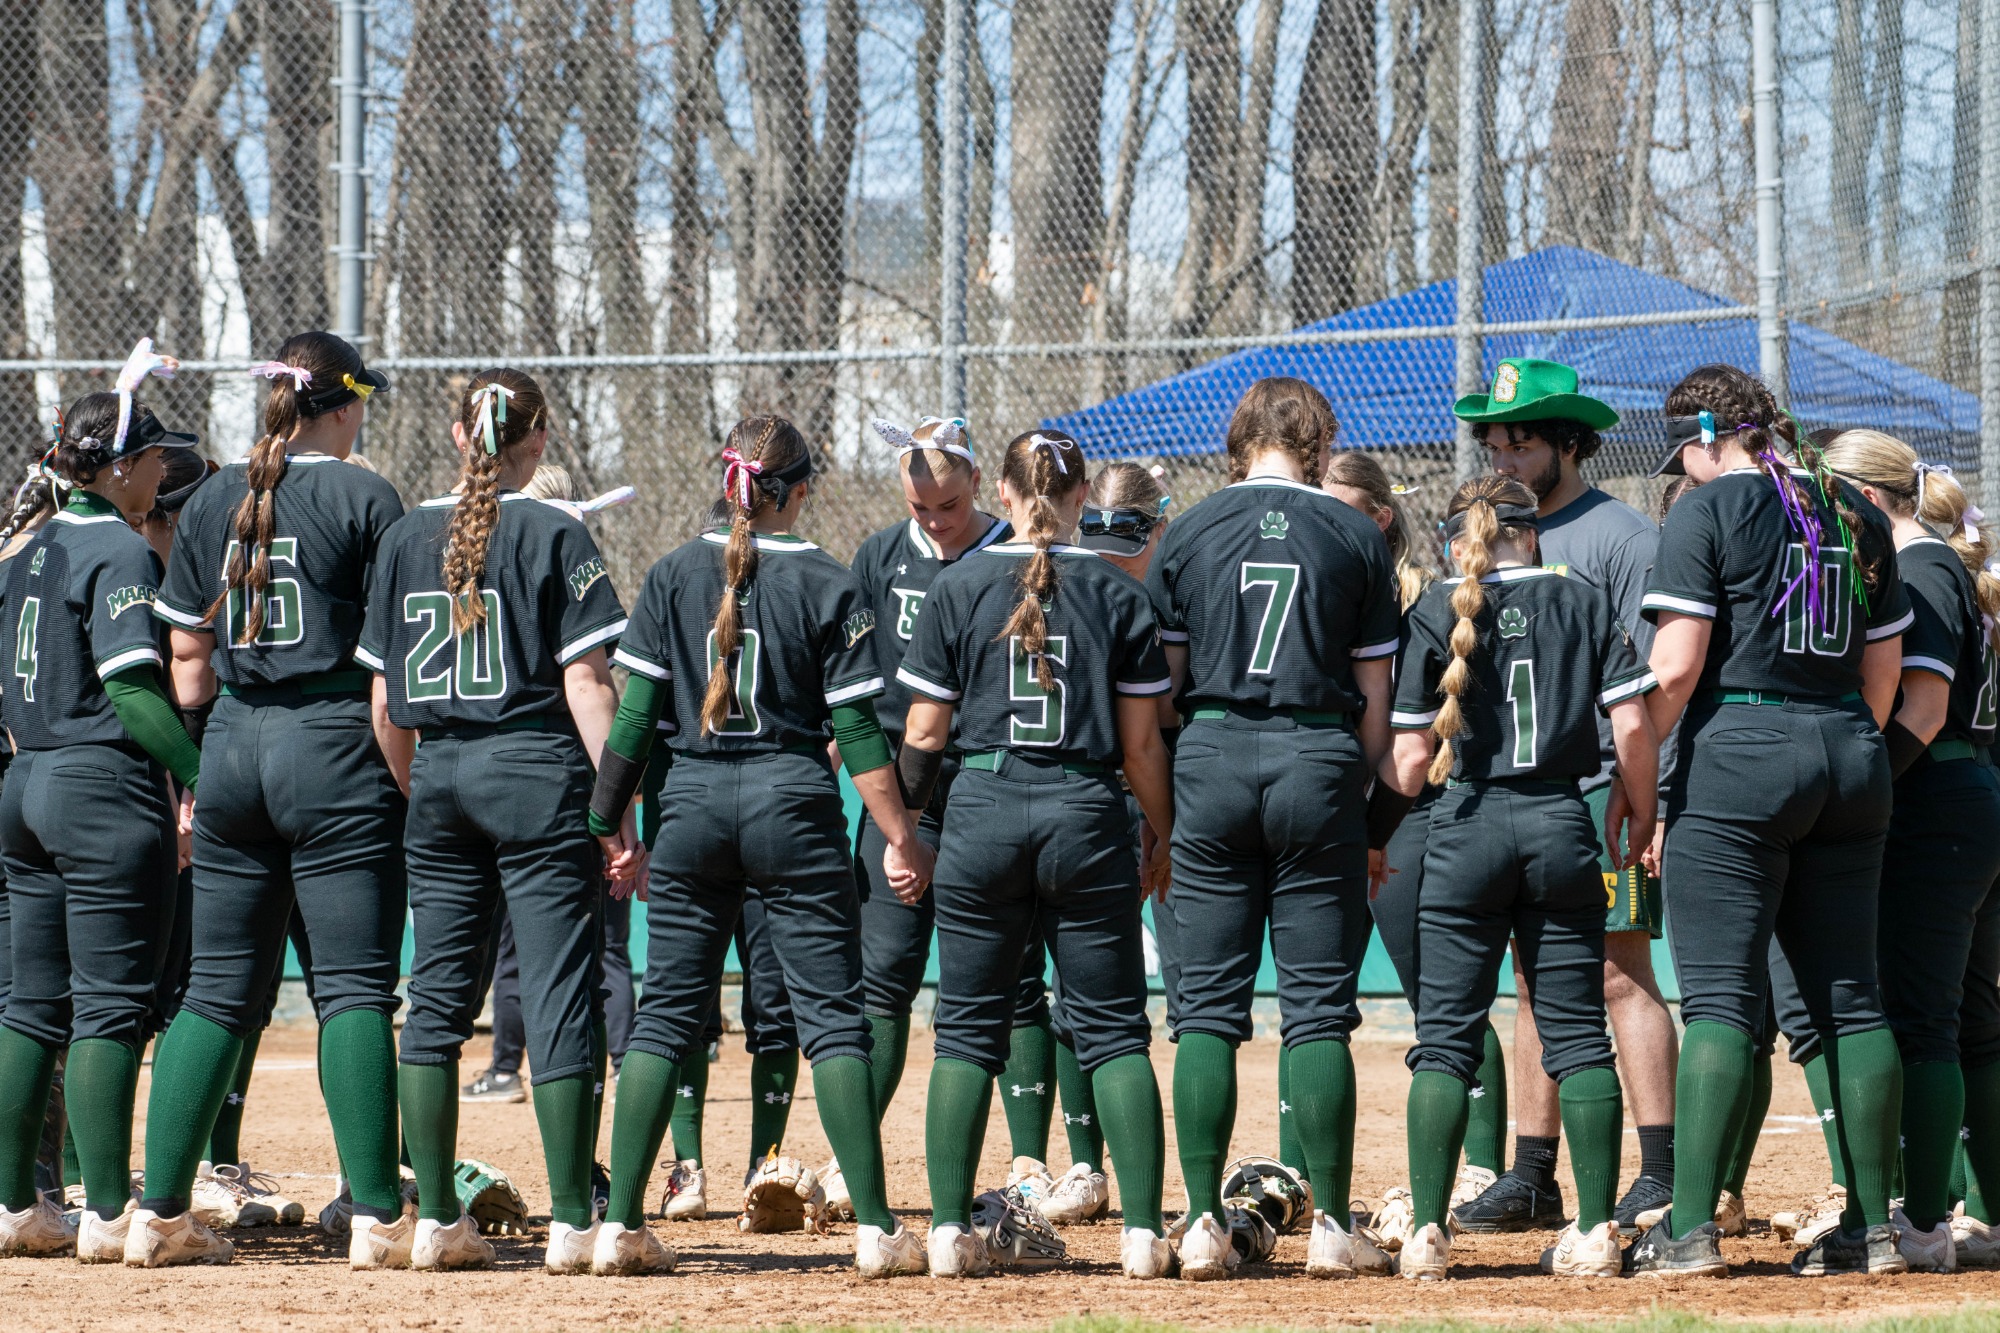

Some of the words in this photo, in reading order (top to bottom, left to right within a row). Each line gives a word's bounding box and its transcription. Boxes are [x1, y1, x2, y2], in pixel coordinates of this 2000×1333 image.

[1494, 362, 1519, 402] S
[15, 595, 41, 702] 4
[221, 537, 304, 649] 16
[404, 588, 508, 703] 20
[1240, 561, 1300, 675] 7
[1781, 543, 1854, 657] 10
[706, 628, 761, 736] 0
[1009, 635, 1067, 746] 5
[1506, 659, 1537, 768] 1
